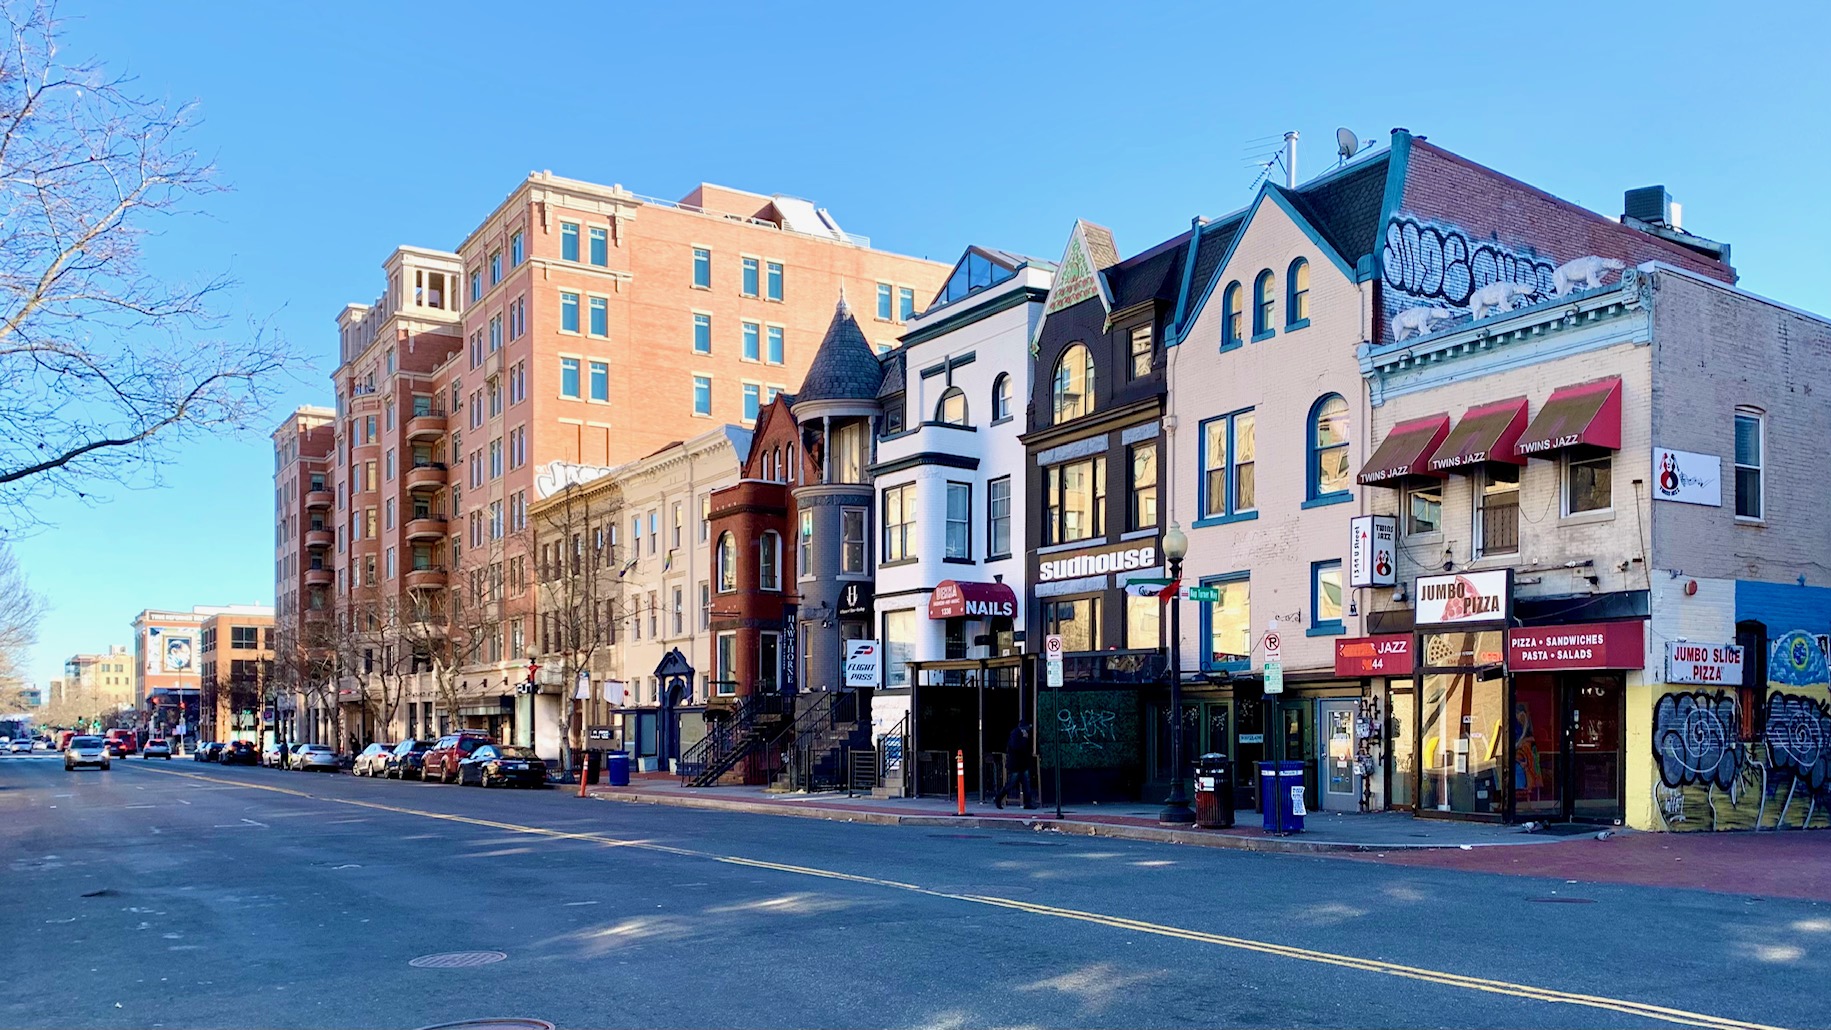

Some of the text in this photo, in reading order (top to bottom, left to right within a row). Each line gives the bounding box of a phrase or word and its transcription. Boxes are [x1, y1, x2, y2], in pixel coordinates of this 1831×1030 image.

[1520, 434, 1578, 455] TWINS JAZZ
[1432, 451, 1485, 470] TWINS JAZZ
[1360, 465, 1408, 483] TWINS JAZZ
[1376, 524, 1394, 533] TWINS
[1421, 582, 1465, 601] JUMBO
[965, 600, 1013, 616] NAILS
[1463, 595, 1500, 614] PIZZA
[787, 615, 795, 683] HAWTHORNE
[1378, 641, 1407, 654] JAZZ
[1512, 634, 1604, 648] PIZZA SANDWICHES
[1522, 649, 1592, 661] PASTA SALADS
[1674, 646, 1740, 664] JUMBO SLICE
[847, 663, 876, 671] FLIGHT
[1693, 665, 1722, 681] PIZZA
